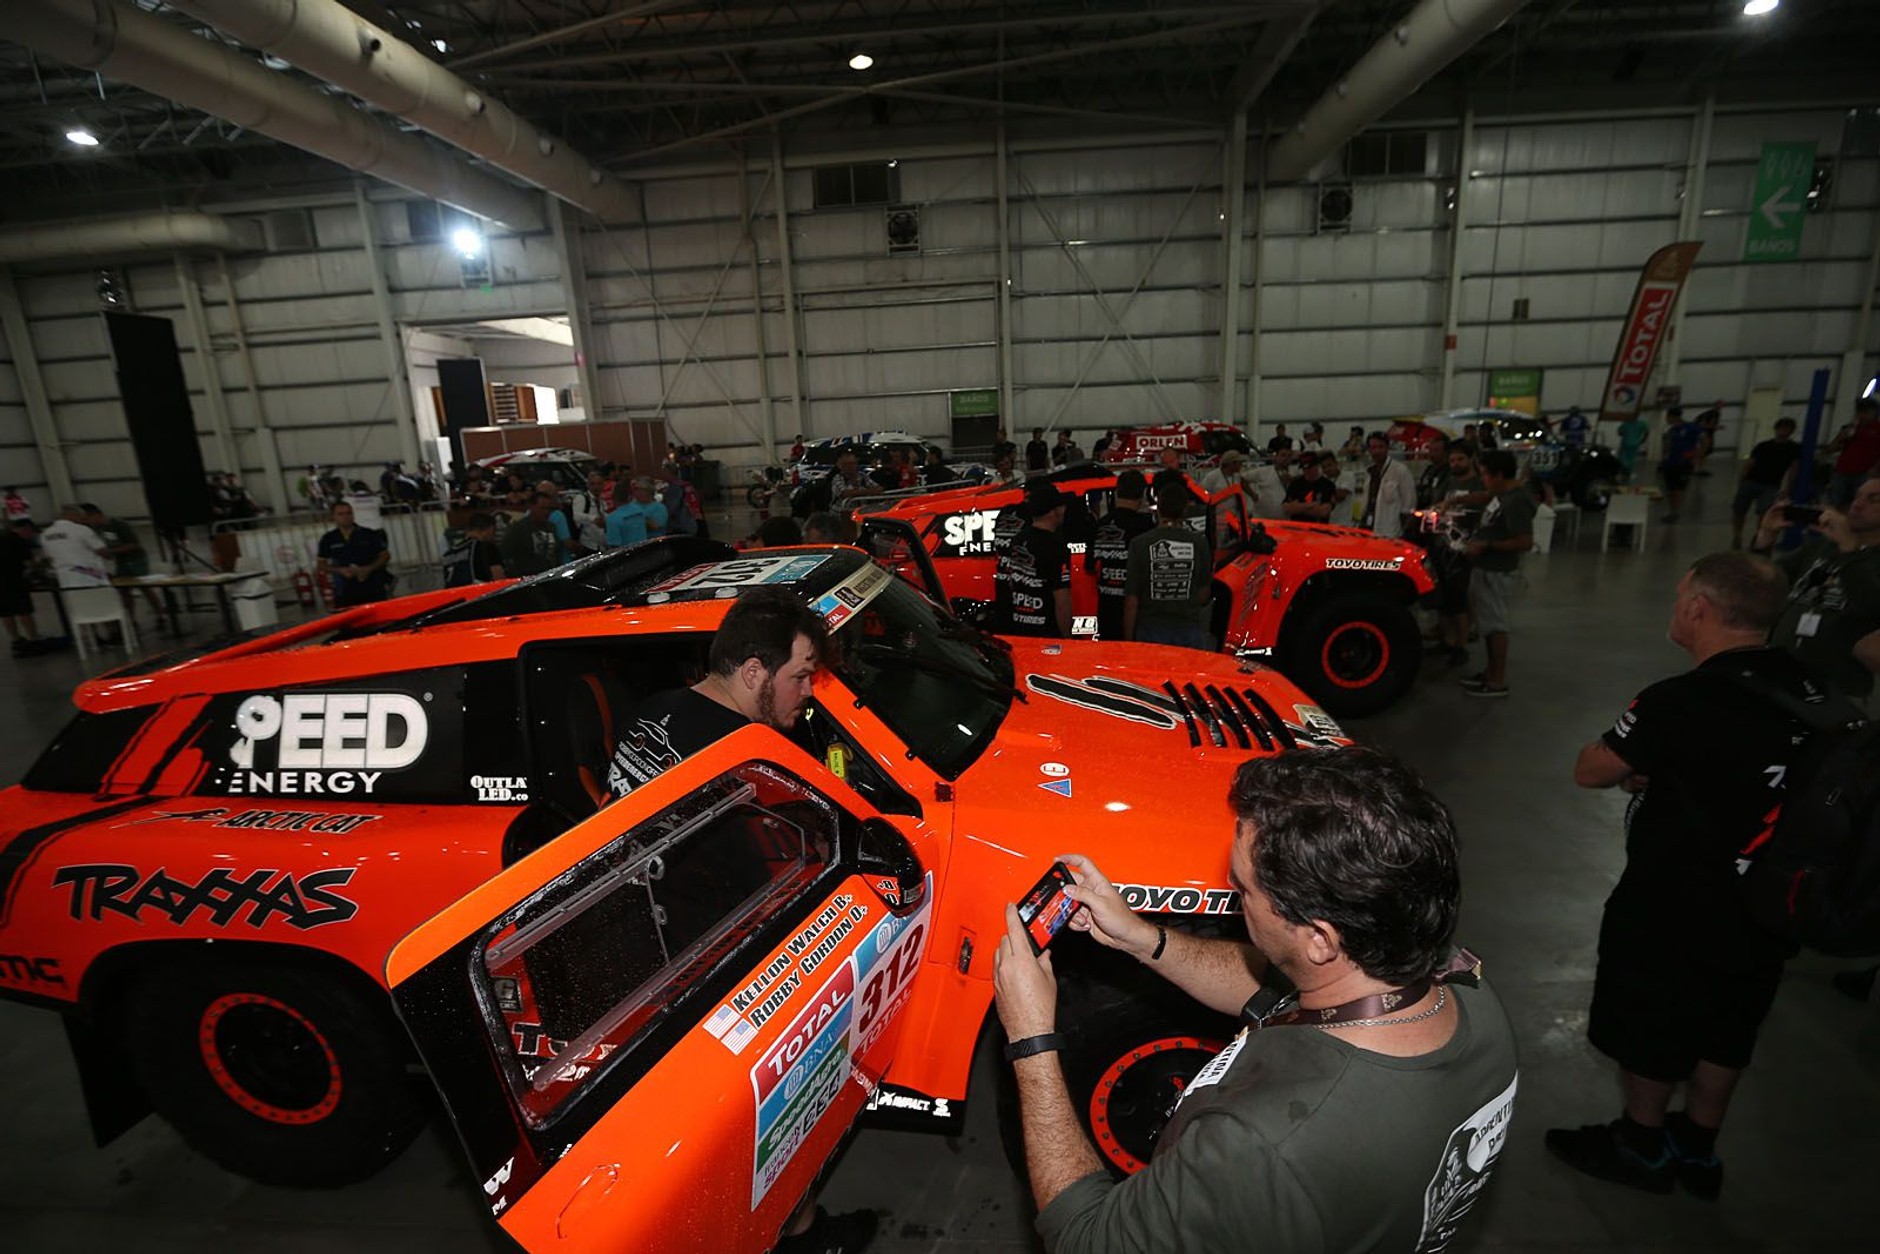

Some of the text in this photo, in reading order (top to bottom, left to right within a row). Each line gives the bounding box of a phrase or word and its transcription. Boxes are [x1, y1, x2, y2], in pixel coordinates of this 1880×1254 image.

[1619, 290, 1670, 381] TOTAL
[1139, 437, 1184, 449] ORLEN
[1326, 558, 1401, 571] TOYO TIRES
[228, 771, 383, 793] ENERGY
[212, 809, 385, 835] ARCTIC CAT
[51, 863, 359, 931] TRAXXAS
[1110, 883, 1201, 914] OYO
[730, 952, 793, 1014] KELLON
[785, 905, 838, 957] WALCH
[748, 969, 802, 1029] ROBBY
[799, 916, 854, 976] GORDON
[859, 923, 924, 1034] 312
[767, 990, 846, 1076] TOTAL
[860, 987, 912, 1053] TOTAL
